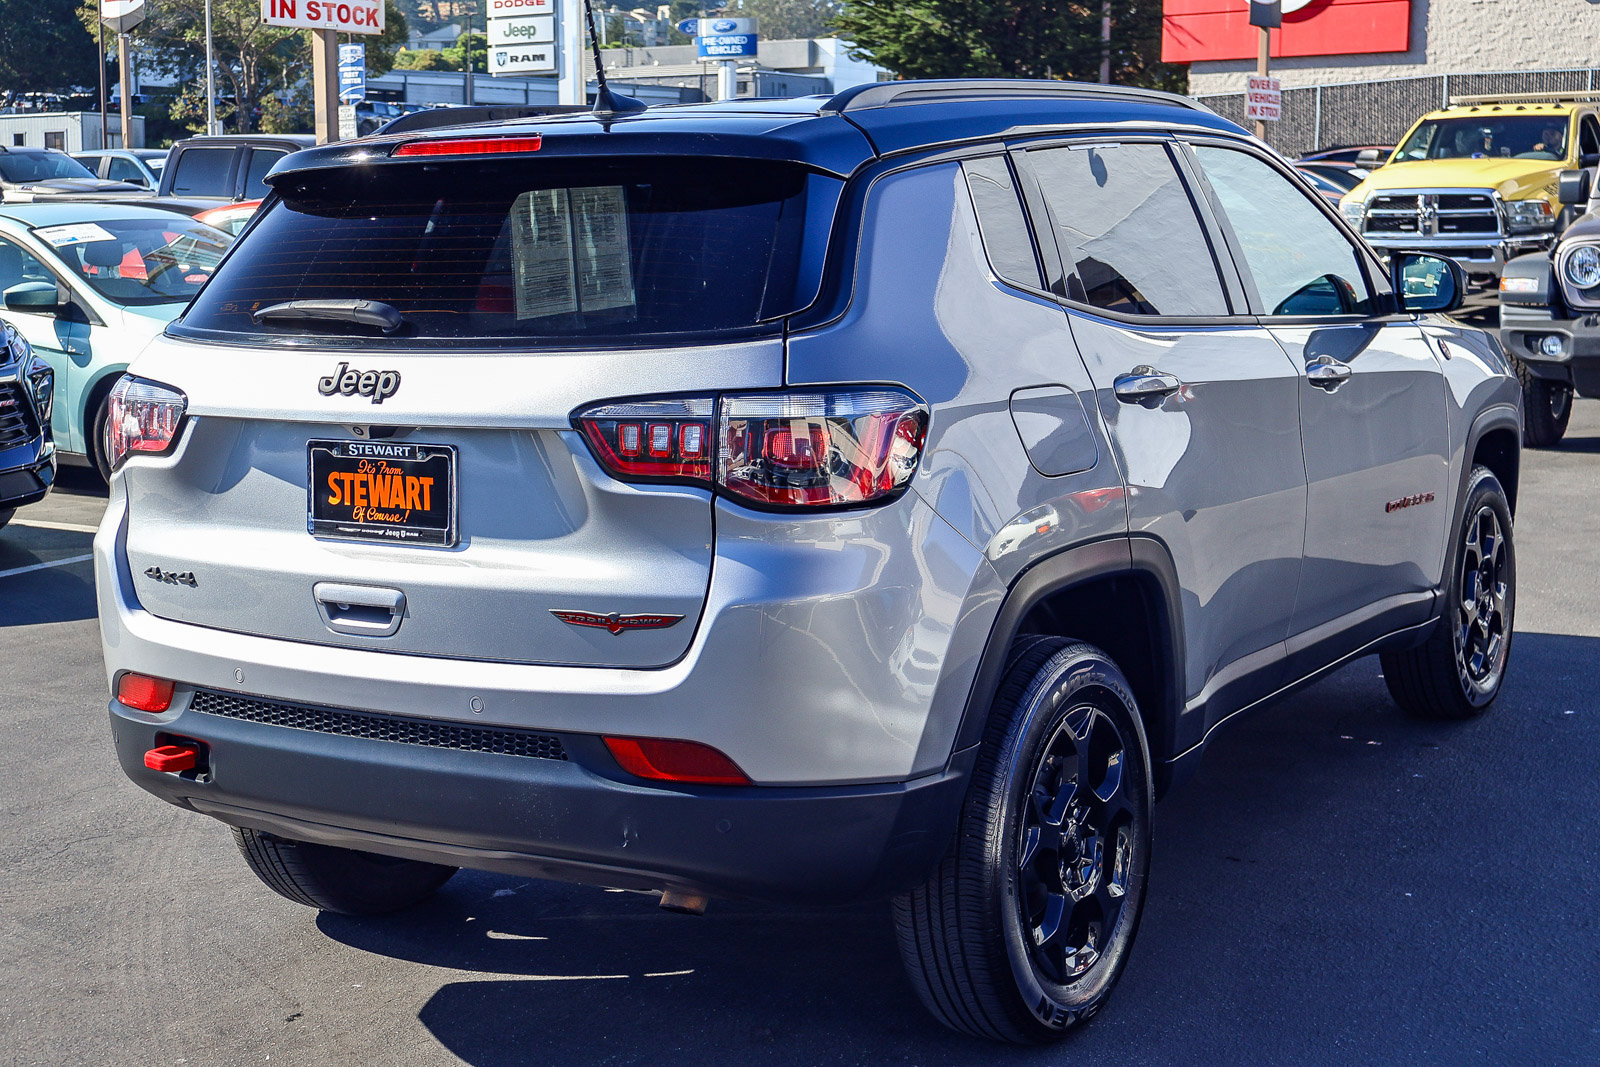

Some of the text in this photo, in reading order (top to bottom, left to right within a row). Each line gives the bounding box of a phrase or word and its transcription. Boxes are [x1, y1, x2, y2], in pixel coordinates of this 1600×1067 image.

[494, 0, 546, 9] DODGE
[270, 0, 379, 27] IN STOCK
[503, 22, 537, 39] Jeep
[702, 36, 748, 46] PRE-OWNED
[706, 45, 743, 55] VEHICLES
[510, 53, 546, 63] RAM
[1249, 79, 1270, 90] OVER
[1248, 105, 1258, 115] IN
[318, 361, 401, 405] Jeep
[348, 443, 411, 457] STEWART
[358, 459, 405, 476] It's From
[327, 471, 434, 512] STEWART
[352, 505, 366, 523] Of
